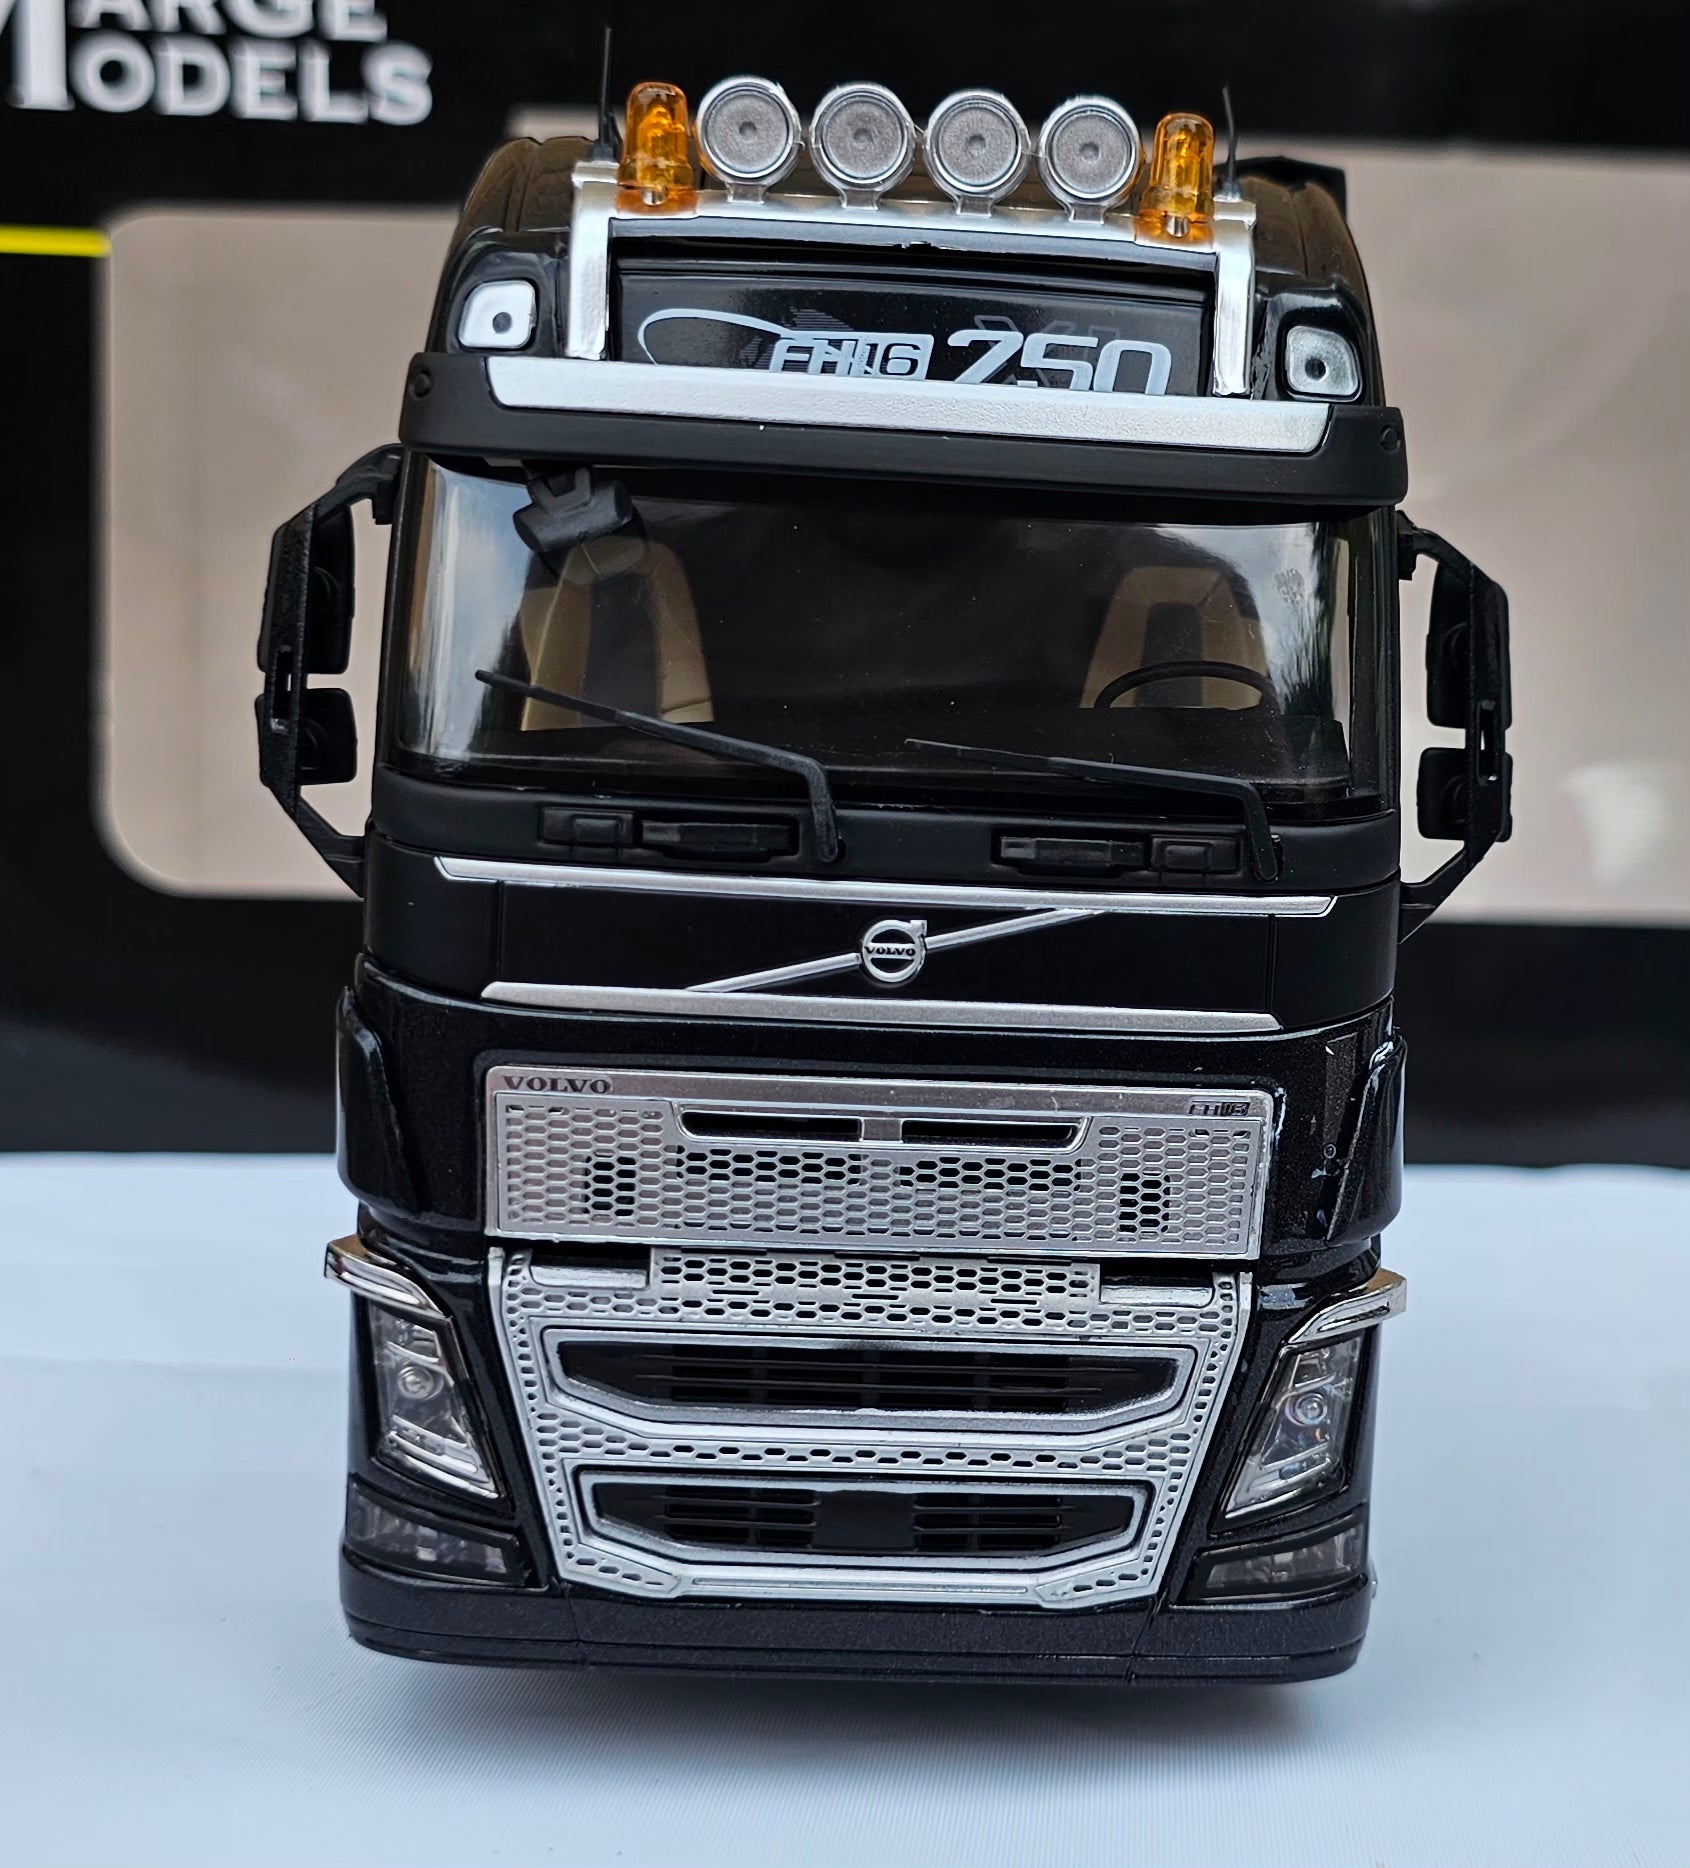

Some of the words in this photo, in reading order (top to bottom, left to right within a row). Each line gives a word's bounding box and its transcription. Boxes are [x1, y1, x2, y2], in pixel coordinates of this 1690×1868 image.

[947, 329, 1172, 395] 750
[864, 946, 916, 957] VOLVO
[503, 1075, 612, 1094] VOLVO
